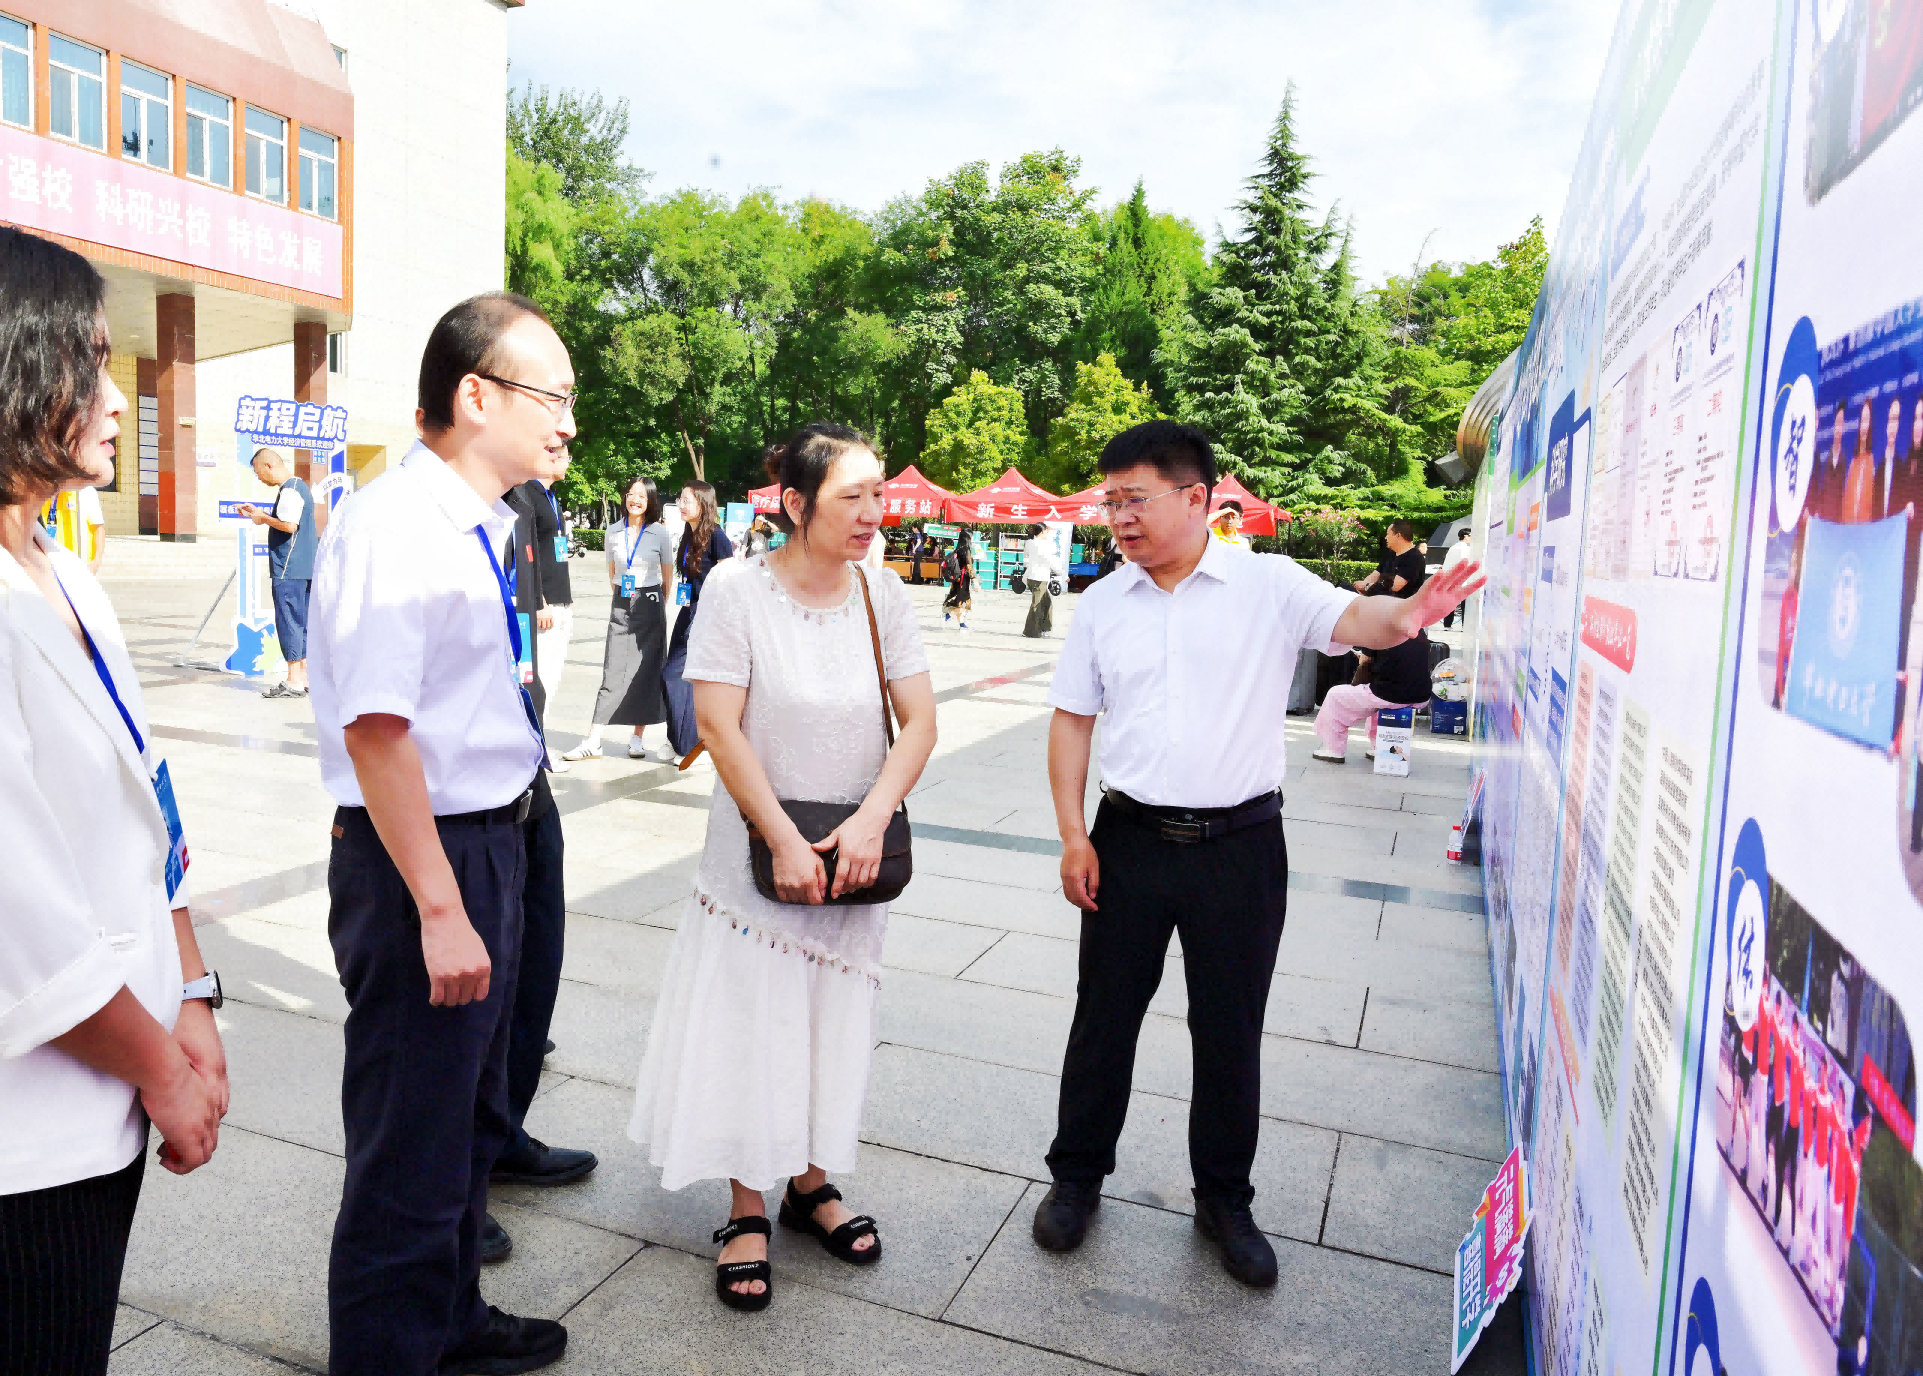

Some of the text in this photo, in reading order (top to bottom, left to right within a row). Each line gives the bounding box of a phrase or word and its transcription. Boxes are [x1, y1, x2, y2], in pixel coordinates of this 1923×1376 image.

[0, 153, 322, 276] 强校 科研兴校 特色发展
[236, 397, 347, 441] 新程启航
[1784, 415, 1806, 499] 智
[1494, 1163, 1514, 1260] 元气满满
[1461, 1231, 1482, 1330] 喜提开学
